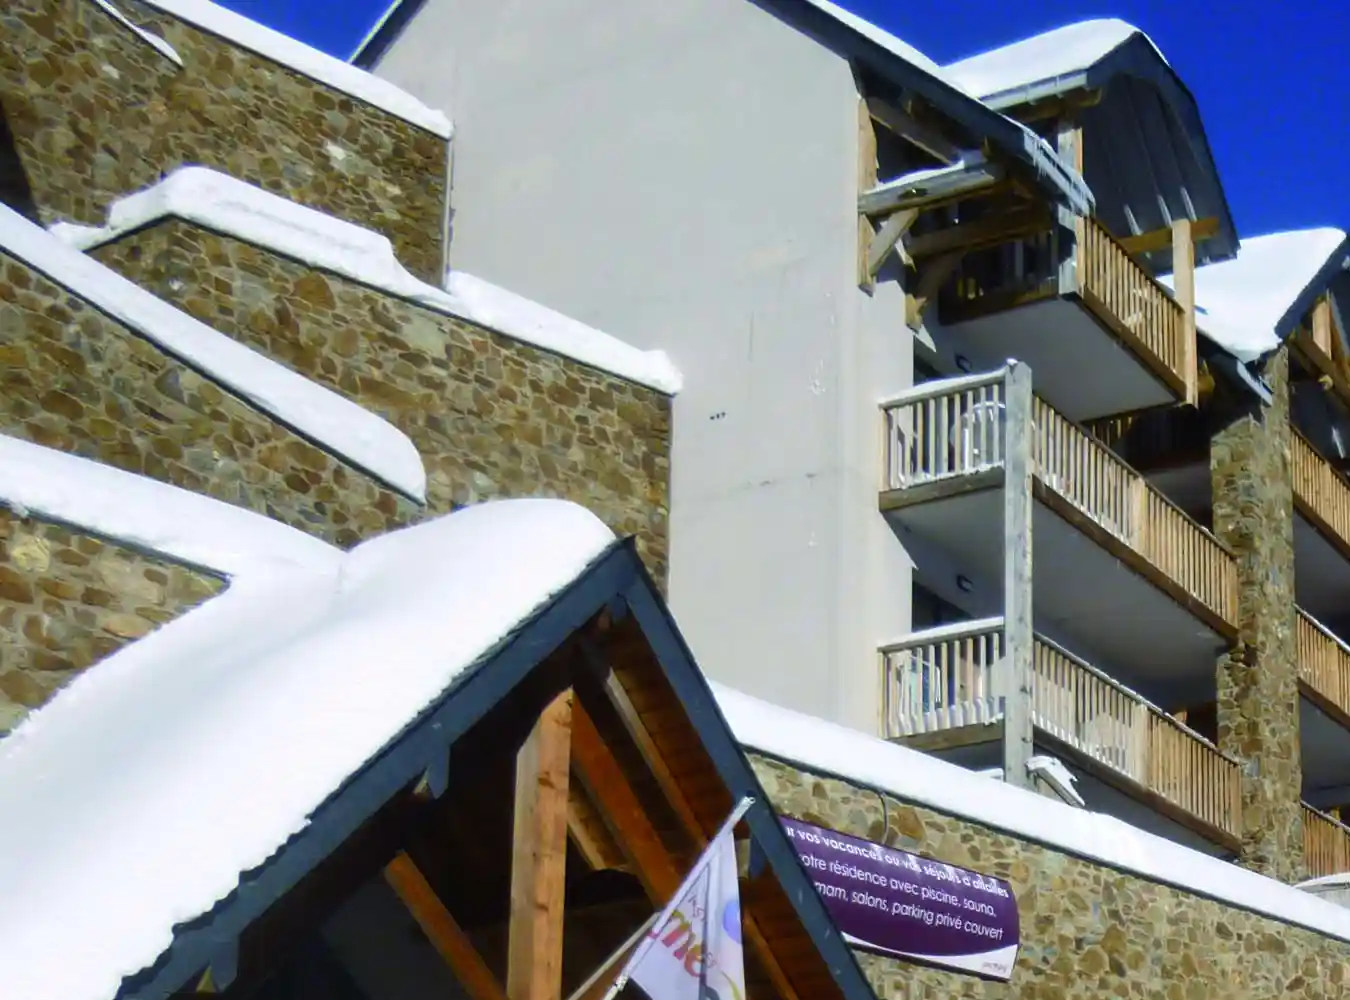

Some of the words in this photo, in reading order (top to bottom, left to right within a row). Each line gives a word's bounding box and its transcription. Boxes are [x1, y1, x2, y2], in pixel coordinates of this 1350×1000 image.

[800, 853, 827, 870] otre
[830, 859, 888, 888] résidence
[890, 877, 919, 896] avec
[921, 885, 962, 908] piscine,
[891, 901, 934, 925] parking
[935, 913, 962, 930] privé
[964, 920, 1003, 940] couvert
